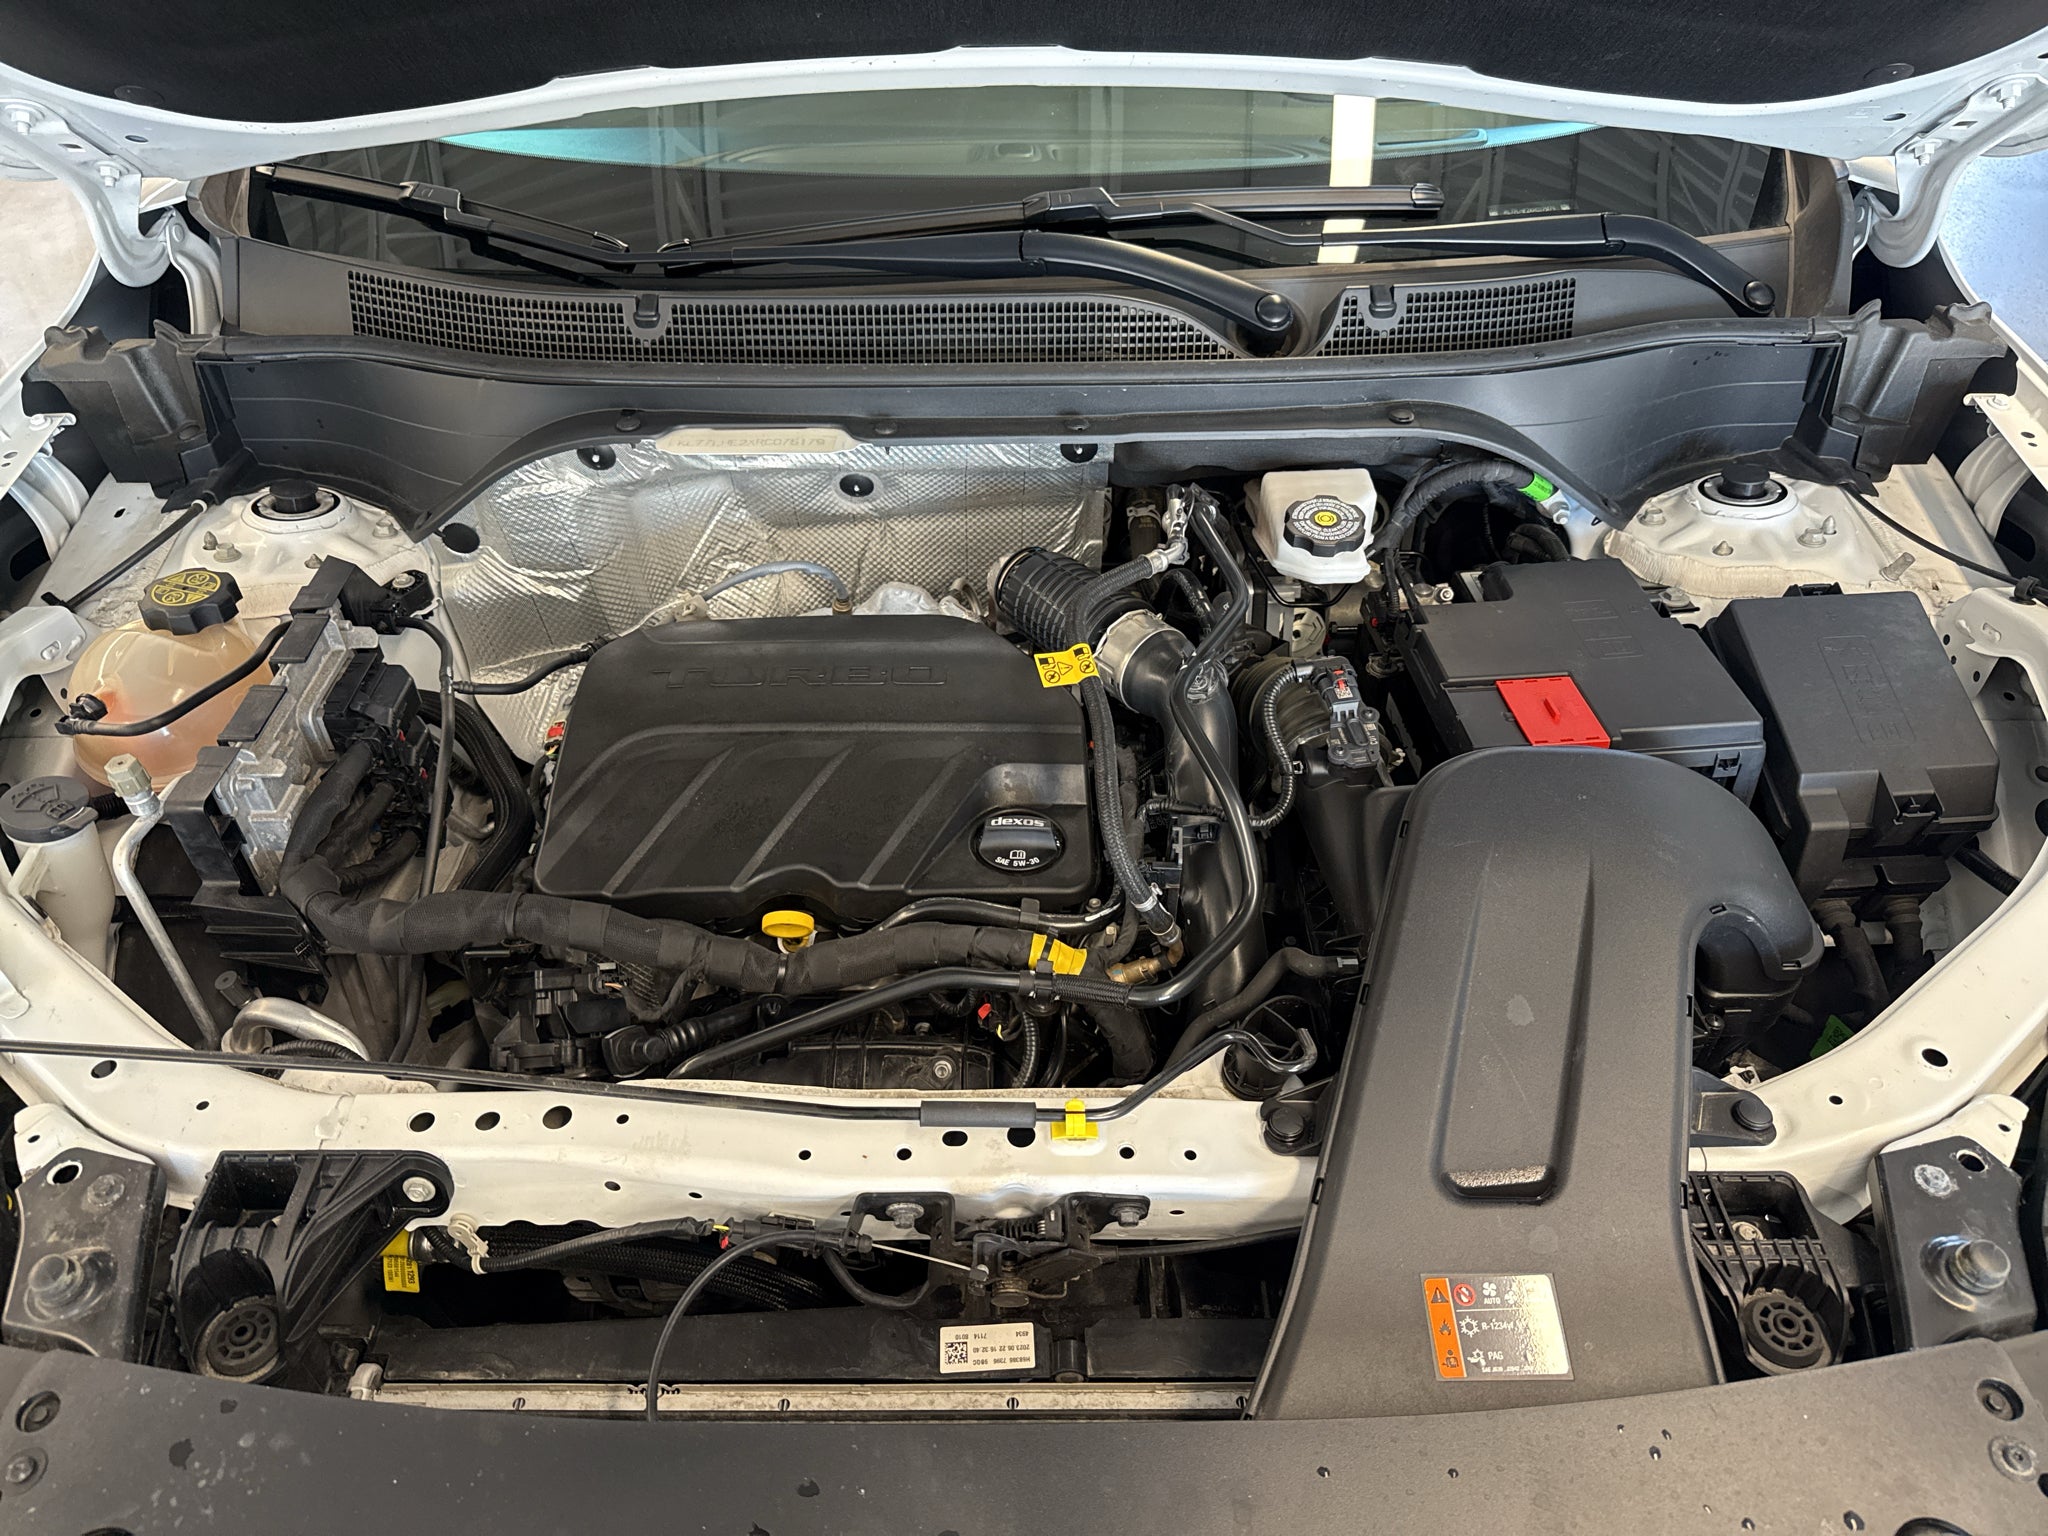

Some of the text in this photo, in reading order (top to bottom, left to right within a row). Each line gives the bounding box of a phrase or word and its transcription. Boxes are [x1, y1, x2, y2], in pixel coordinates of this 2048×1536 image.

[651, 665, 948, 688] TURBO
[990, 817, 1045, 827] dexos
[995, 856, 1040, 867] SAE 5W-30
[1488, 1351, 1504, 1360] PAG
